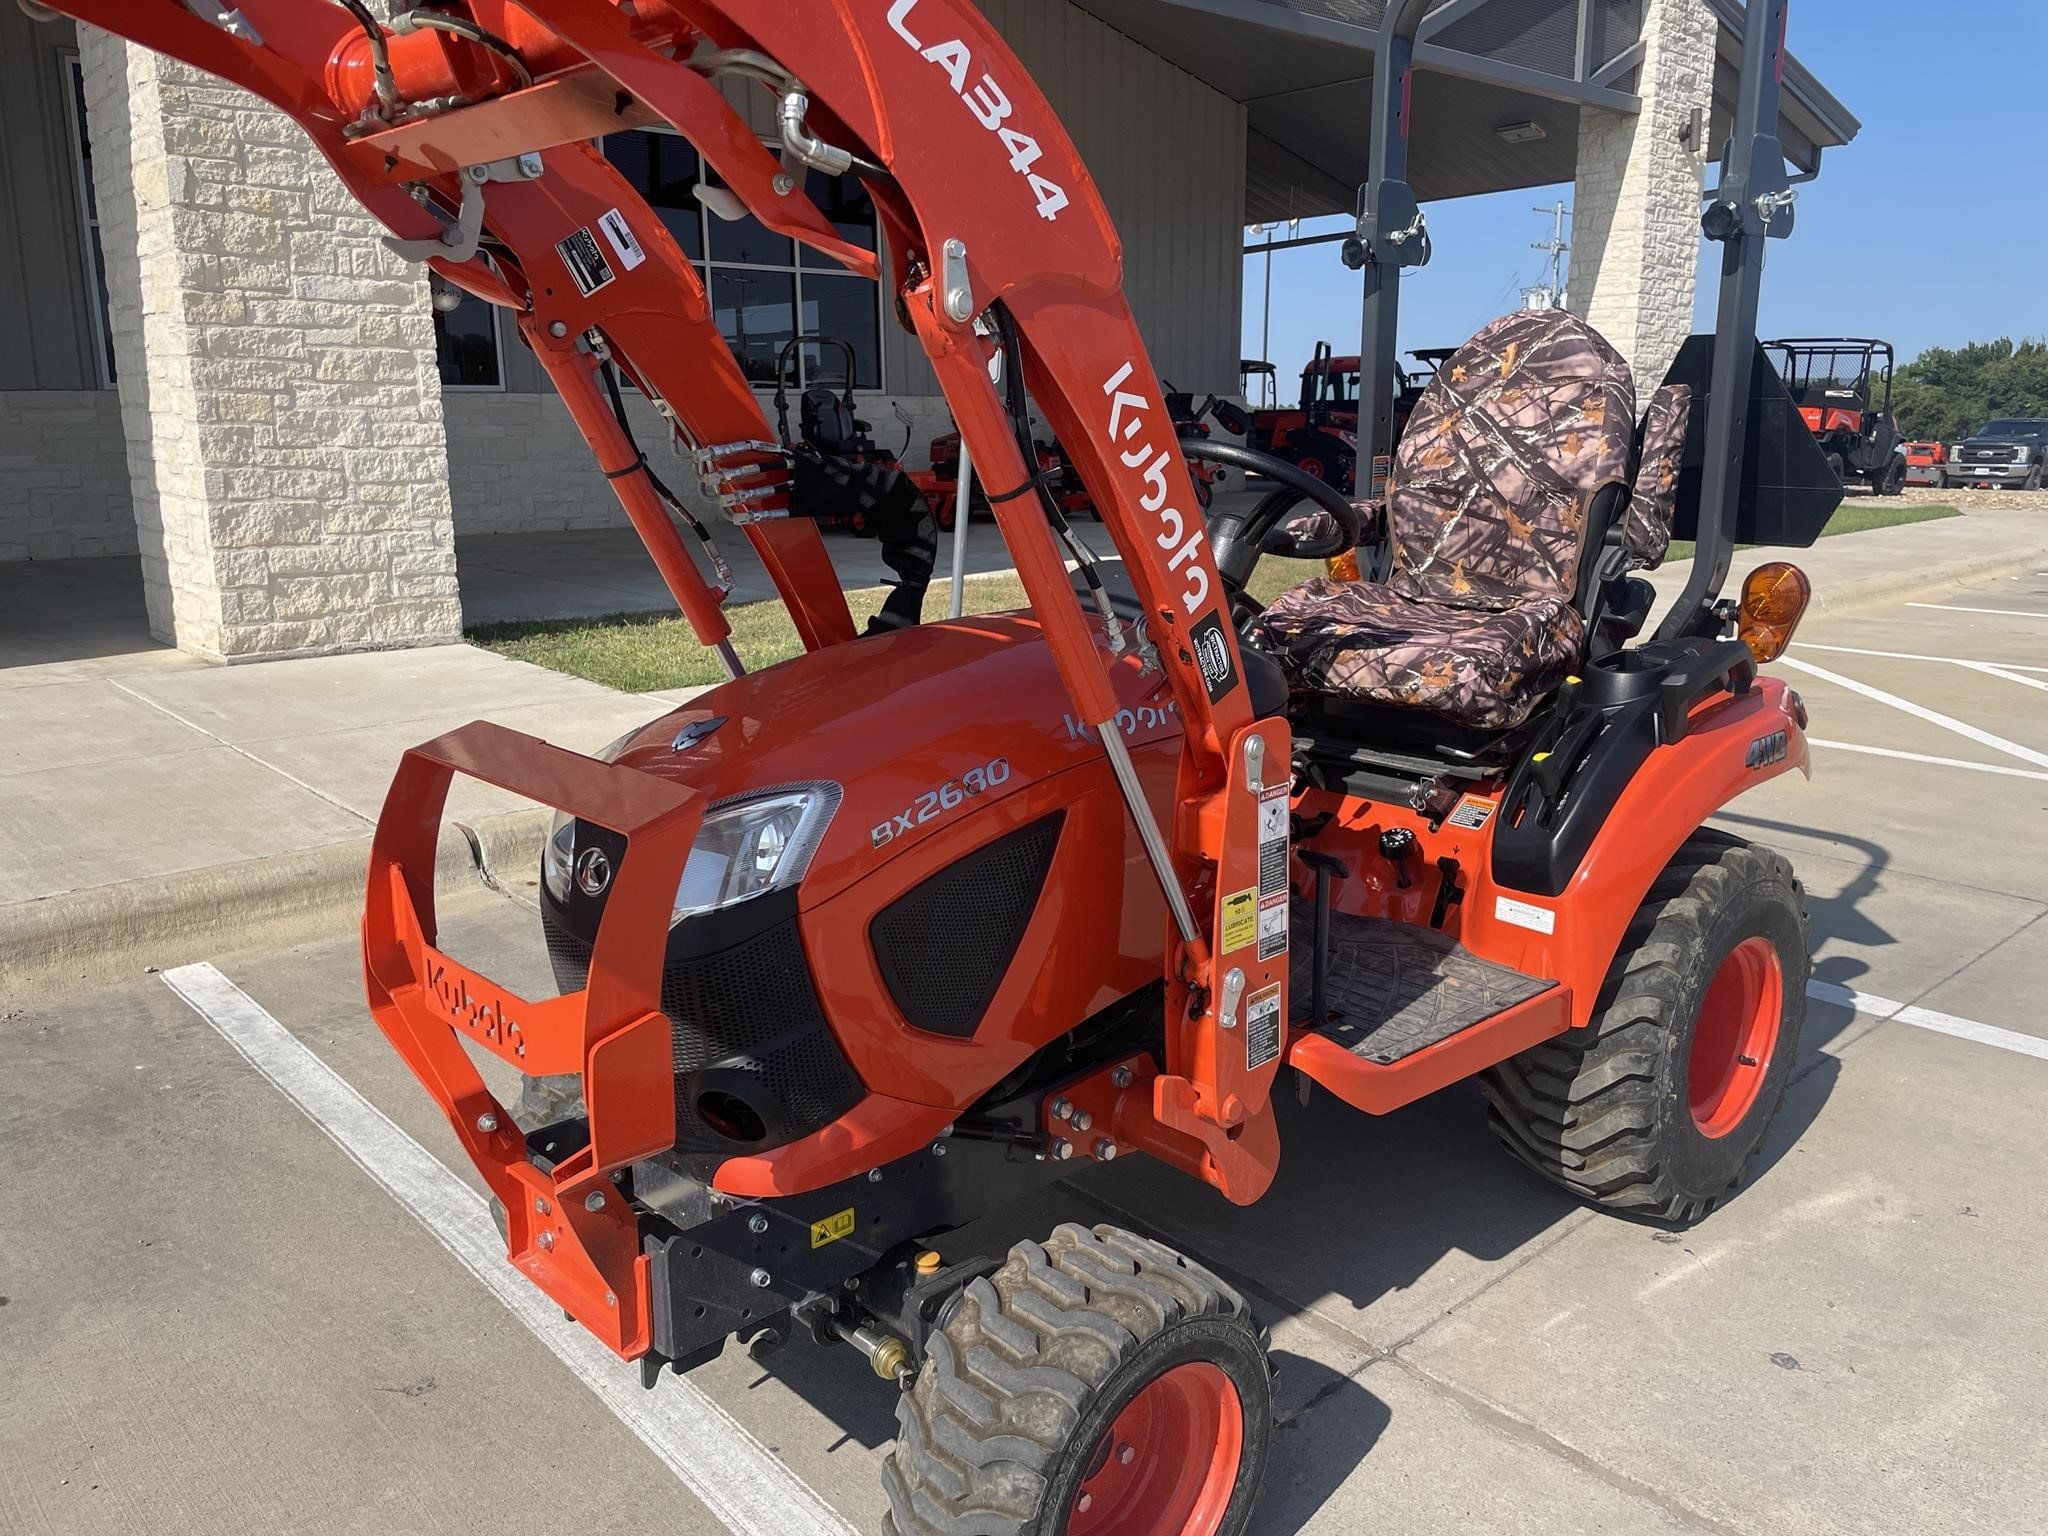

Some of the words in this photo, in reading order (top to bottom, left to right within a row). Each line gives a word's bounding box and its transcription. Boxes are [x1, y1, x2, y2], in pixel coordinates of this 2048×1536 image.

[887, 0, 1069, 221] LA344
[581, 229, 599, 260] Kubota
[1103, 361, 1209, 614] Kubota
[1193, 638, 1214, 693] WCTRACTOR.COM
[871, 756, 1010, 849] BX2680
[1265, 786, 1288, 799] DANGER
[1225, 916, 1253, 931] LUBRICATE
[1265, 894, 1287, 907] DANGER
[427, 959, 525, 1058] Kubota
